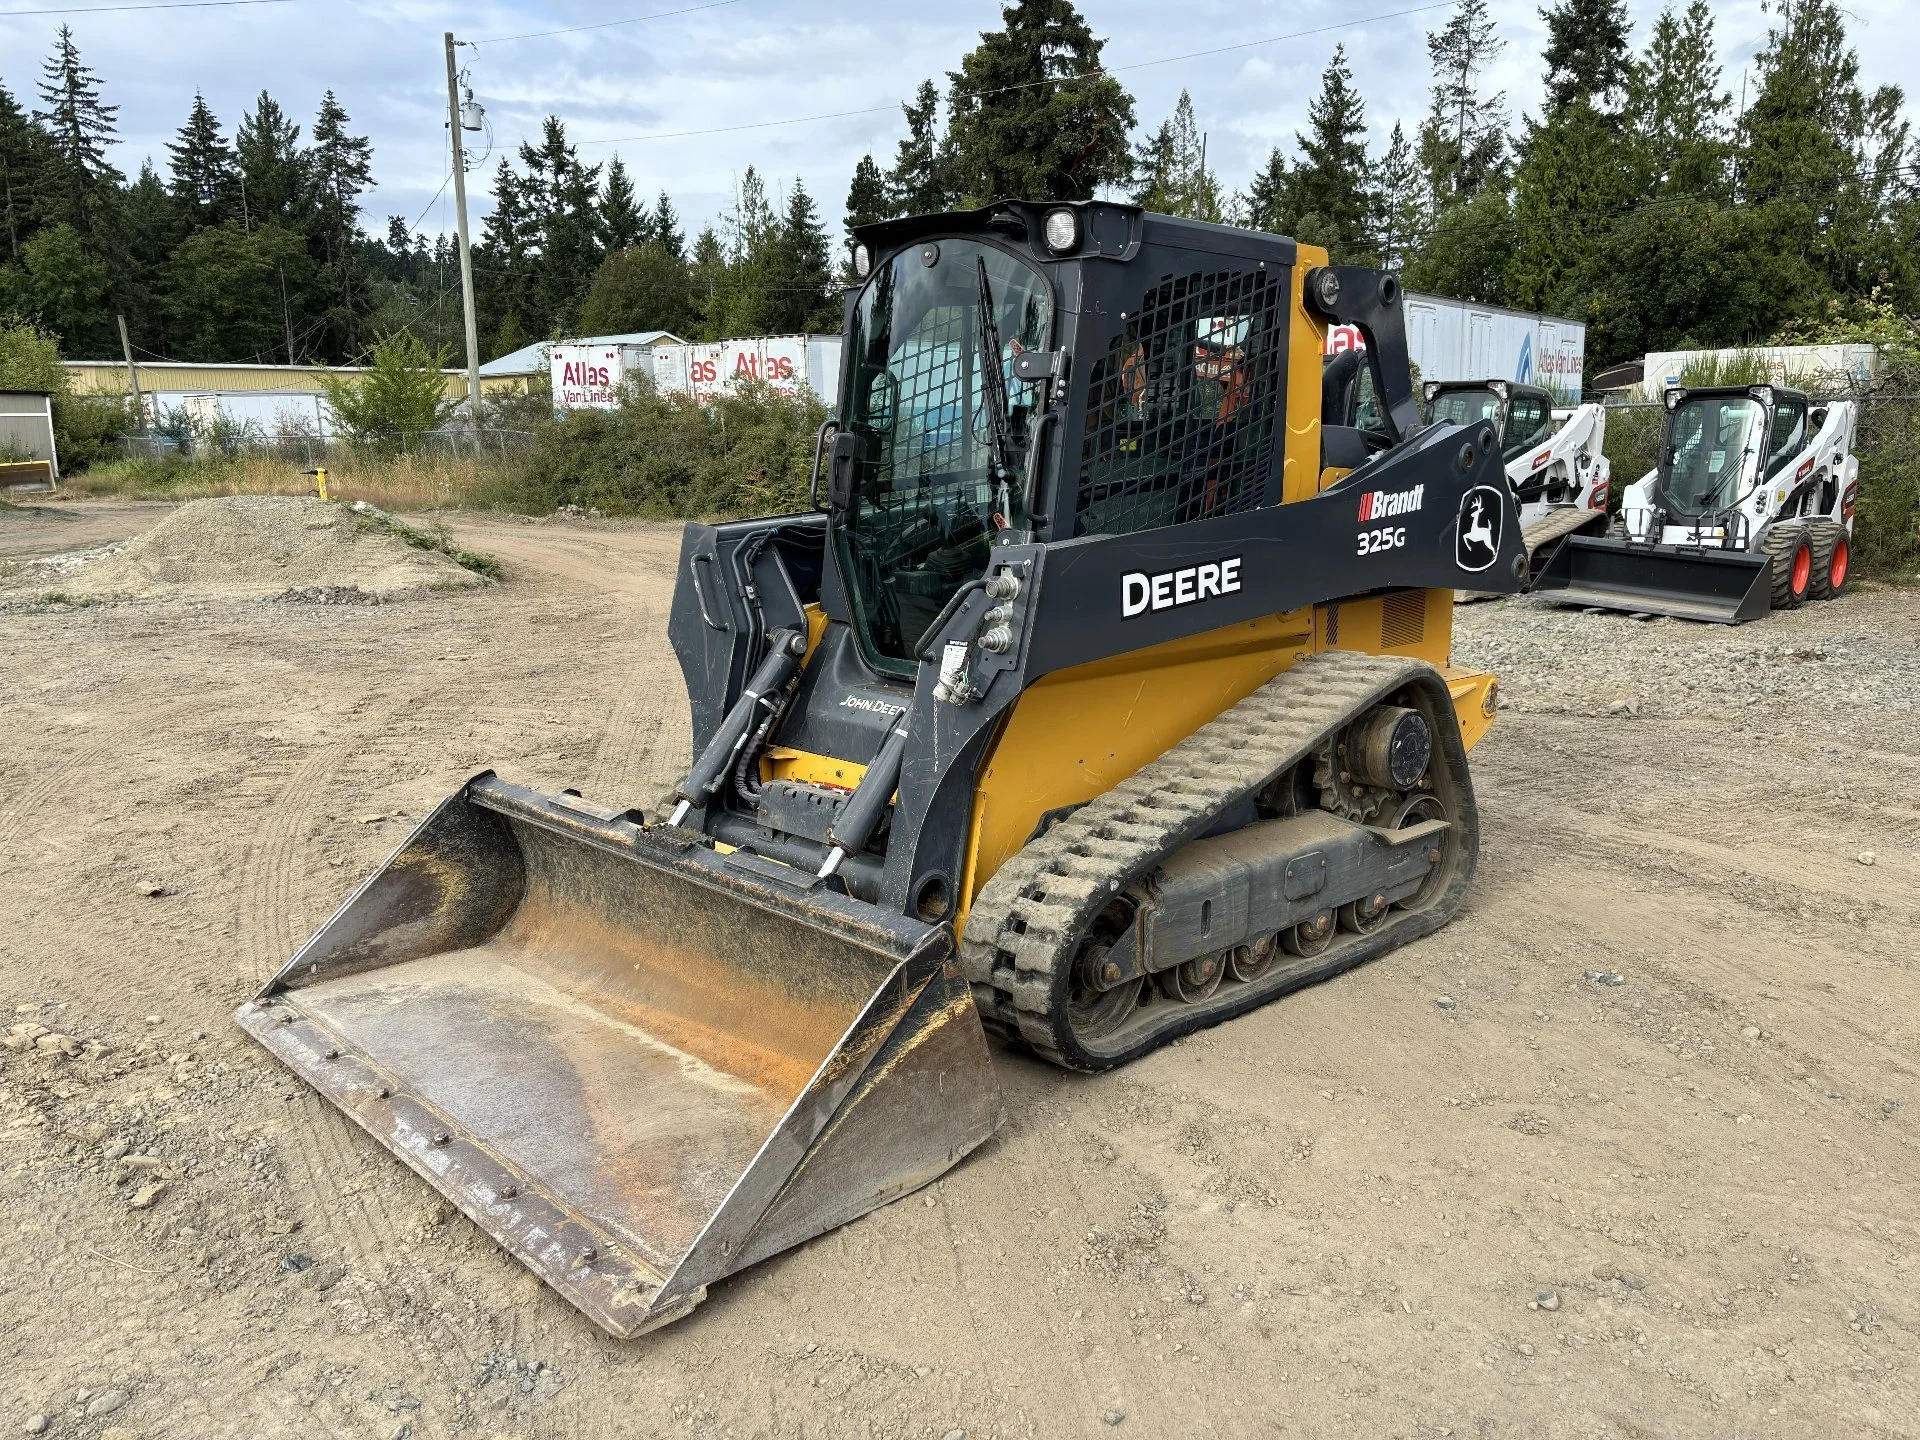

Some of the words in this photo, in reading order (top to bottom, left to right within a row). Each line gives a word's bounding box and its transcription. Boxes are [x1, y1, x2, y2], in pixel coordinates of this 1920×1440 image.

[562, 361, 609, 387] Atlas
[562, 389, 582, 403] Van
[582, 389, 614, 403] Lines
[1370, 483, 1425, 520] Brandt
[1356, 526, 1406, 557] 325G
[1121, 557, 1242, 619] DEERE
[840, 694, 873, 711] JOHN
